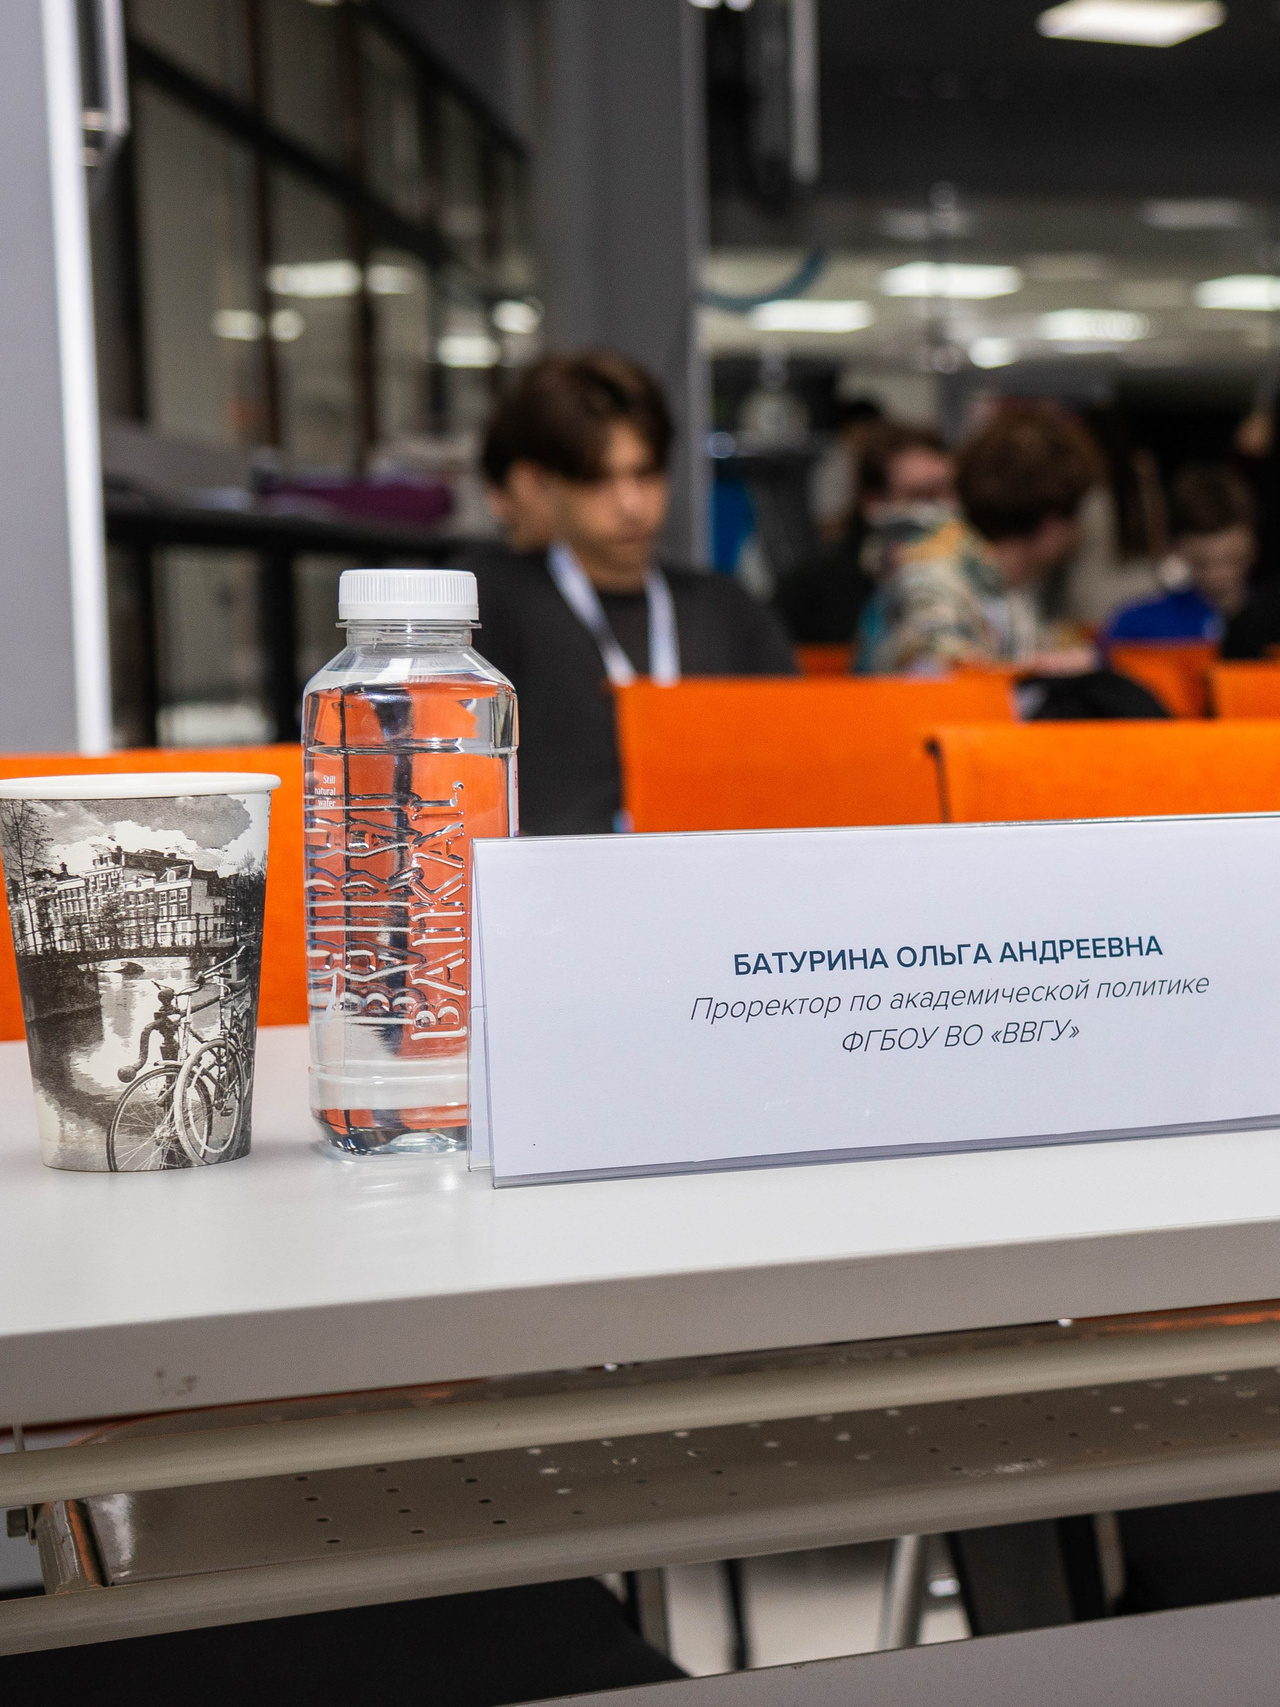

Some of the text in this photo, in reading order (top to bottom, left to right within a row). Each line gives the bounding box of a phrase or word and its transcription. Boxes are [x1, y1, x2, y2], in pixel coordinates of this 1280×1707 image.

[314, 785, 336, 796] natural
[322, 774, 336, 785] Still
[317, 798, 336, 808] water
[410, 783, 468, 1040] BAIKAL
[733, 935, 1164, 976] БАТУРИНА ОЛЬГА АНДРЕЕВНА
[690, 977, 1210, 1025] Проректор по академической политике
[841, 1019, 1080, 1053] ФГБОУ ВО «ВВГУ»
